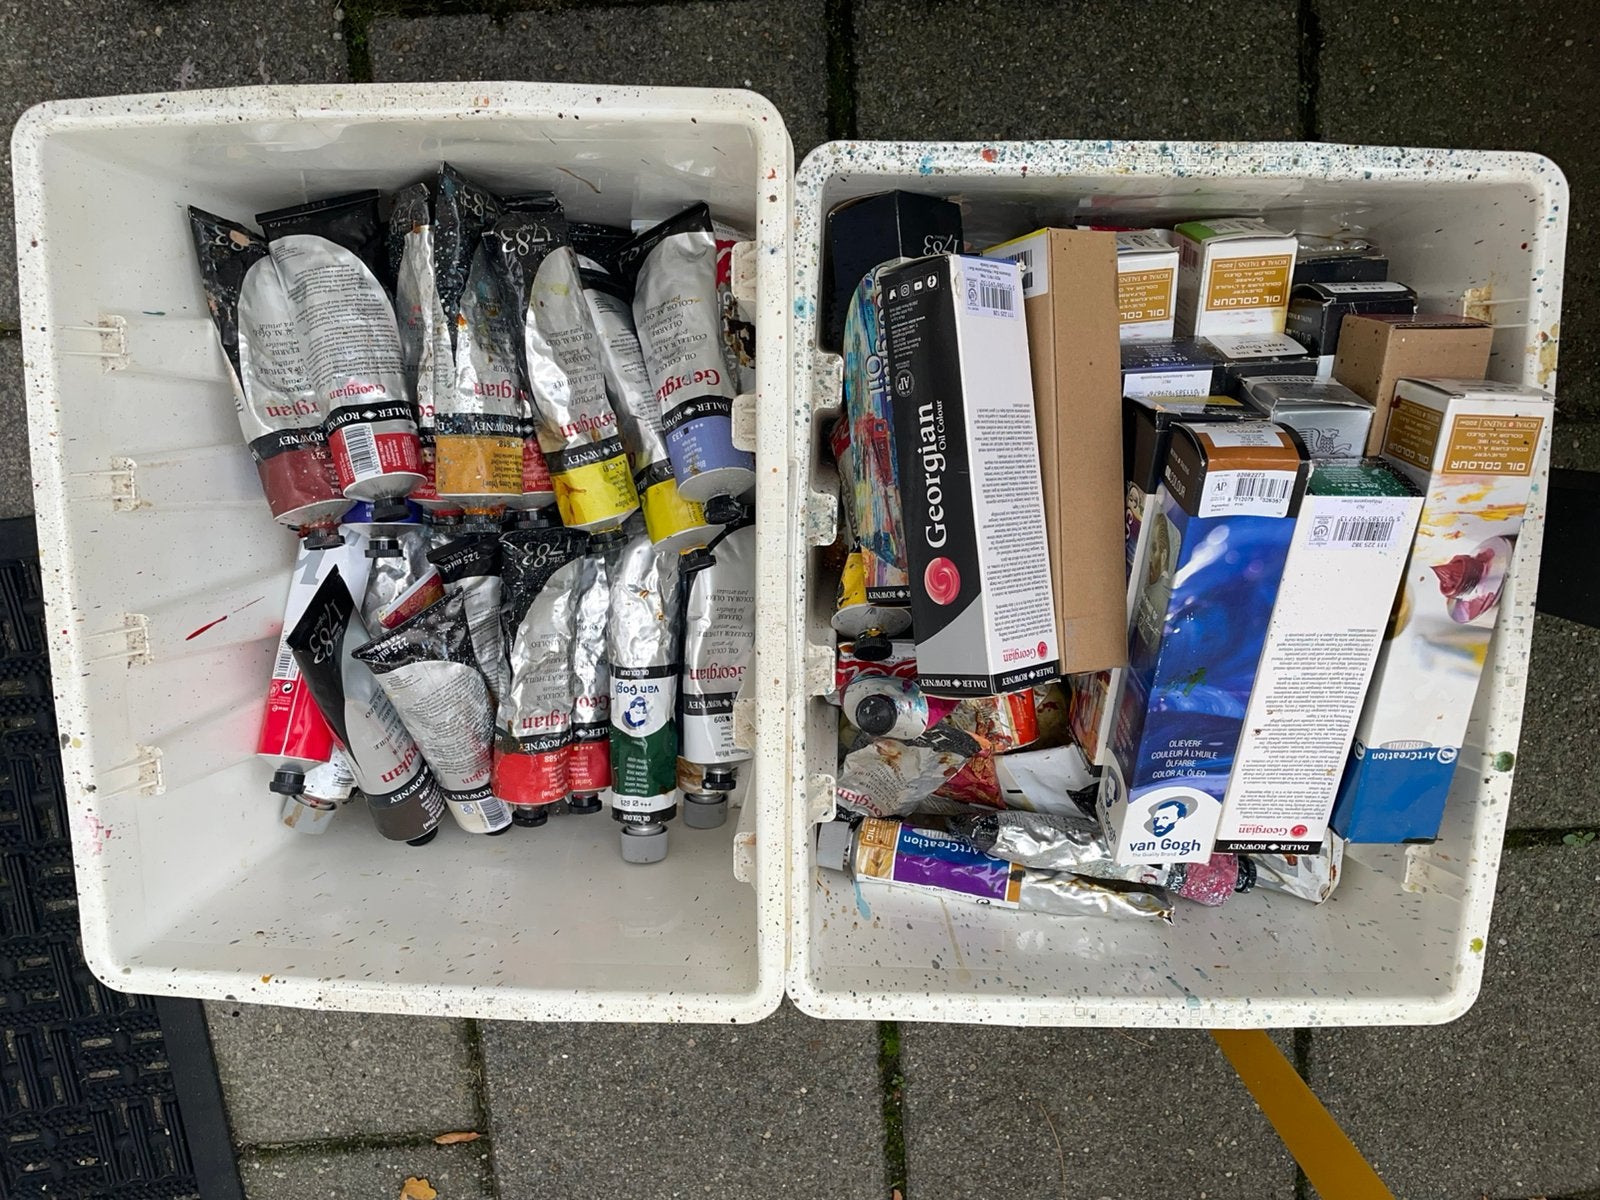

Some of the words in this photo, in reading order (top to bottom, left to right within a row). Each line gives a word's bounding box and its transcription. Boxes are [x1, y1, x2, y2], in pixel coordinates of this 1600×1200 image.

[500, 223, 553, 256] 1783
[923, 234, 958, 255] 1783
[1213, 296, 1259, 306] COLOUR
[1263, 295, 1281, 303] OIL
[1120, 311, 1143, 319] COL
[1147, 309, 1165, 317] OIL
[866, 355, 884, 395] Oil
[474, 380, 517, 401] rgian
[656, 369, 720, 402] Georgia
[330, 384, 386, 400] Georgian
[266, 400, 320, 419] rgian
[378, 407, 411, 418] DALER
[696, 402, 729, 411] DALER
[662, 412, 682, 430] ROW
[936, 400, 946, 433] Colour
[473, 421, 514, 433] ROWNEY
[278, 432, 324, 447] ROWNEY
[672, 430, 683, 441] 133
[938, 434, 947, 451] Oil
[311, 451, 325, 459] 523
[1389, 442, 1415, 460] COLOUR
[1416, 452, 1429, 466] OIL
[1451, 460, 1502, 470] COLOUR
[1507, 462, 1526, 470] OIL
[917, 402, 948, 549] Georgian
[464, 552, 480, 564] 225
[522, 536, 571, 568] 1783
[868, 590, 896, 599] ROWNEY
[309, 599, 343, 664] 1783
[392, 637, 409, 650] 225
[1003, 648, 1036, 663] Georgian
[1036, 666, 1054, 677] DALER
[920, 679, 951, 687] ROWNEY
[962, 680, 987, 688] DALER
[1002, 672, 1028, 686] ROWNEY
[615, 681, 637, 696] Gog
[640, 685, 659, 694] van
[522, 710, 571, 730] rgian
[589, 727, 608, 737] ALER
[519, 738, 560, 750] ROWNEY
[1169, 740, 1202, 748] OLIEVERF
[544, 754, 557, 763] 588
[1151, 750, 1183, 759] COULEUR
[1185, 750, 1190, 758] À
[1191, 750, 1218, 758] L'HUILE
[1372, 751, 1436, 761] ArtCreation
[462, 767, 491, 785] rgian
[1152, 770, 1175, 779] COLOR
[1187, 769, 1206, 777] ÓLEO
[390, 773, 424, 804] ROWNEY
[450, 789, 491, 800] ROWNEY
[623, 814, 642, 822] COLOUR
[1239, 825, 1288, 837] Georgian
[1130, 841, 1156, 852] van
[1160, 838, 1201, 856] Gogh
